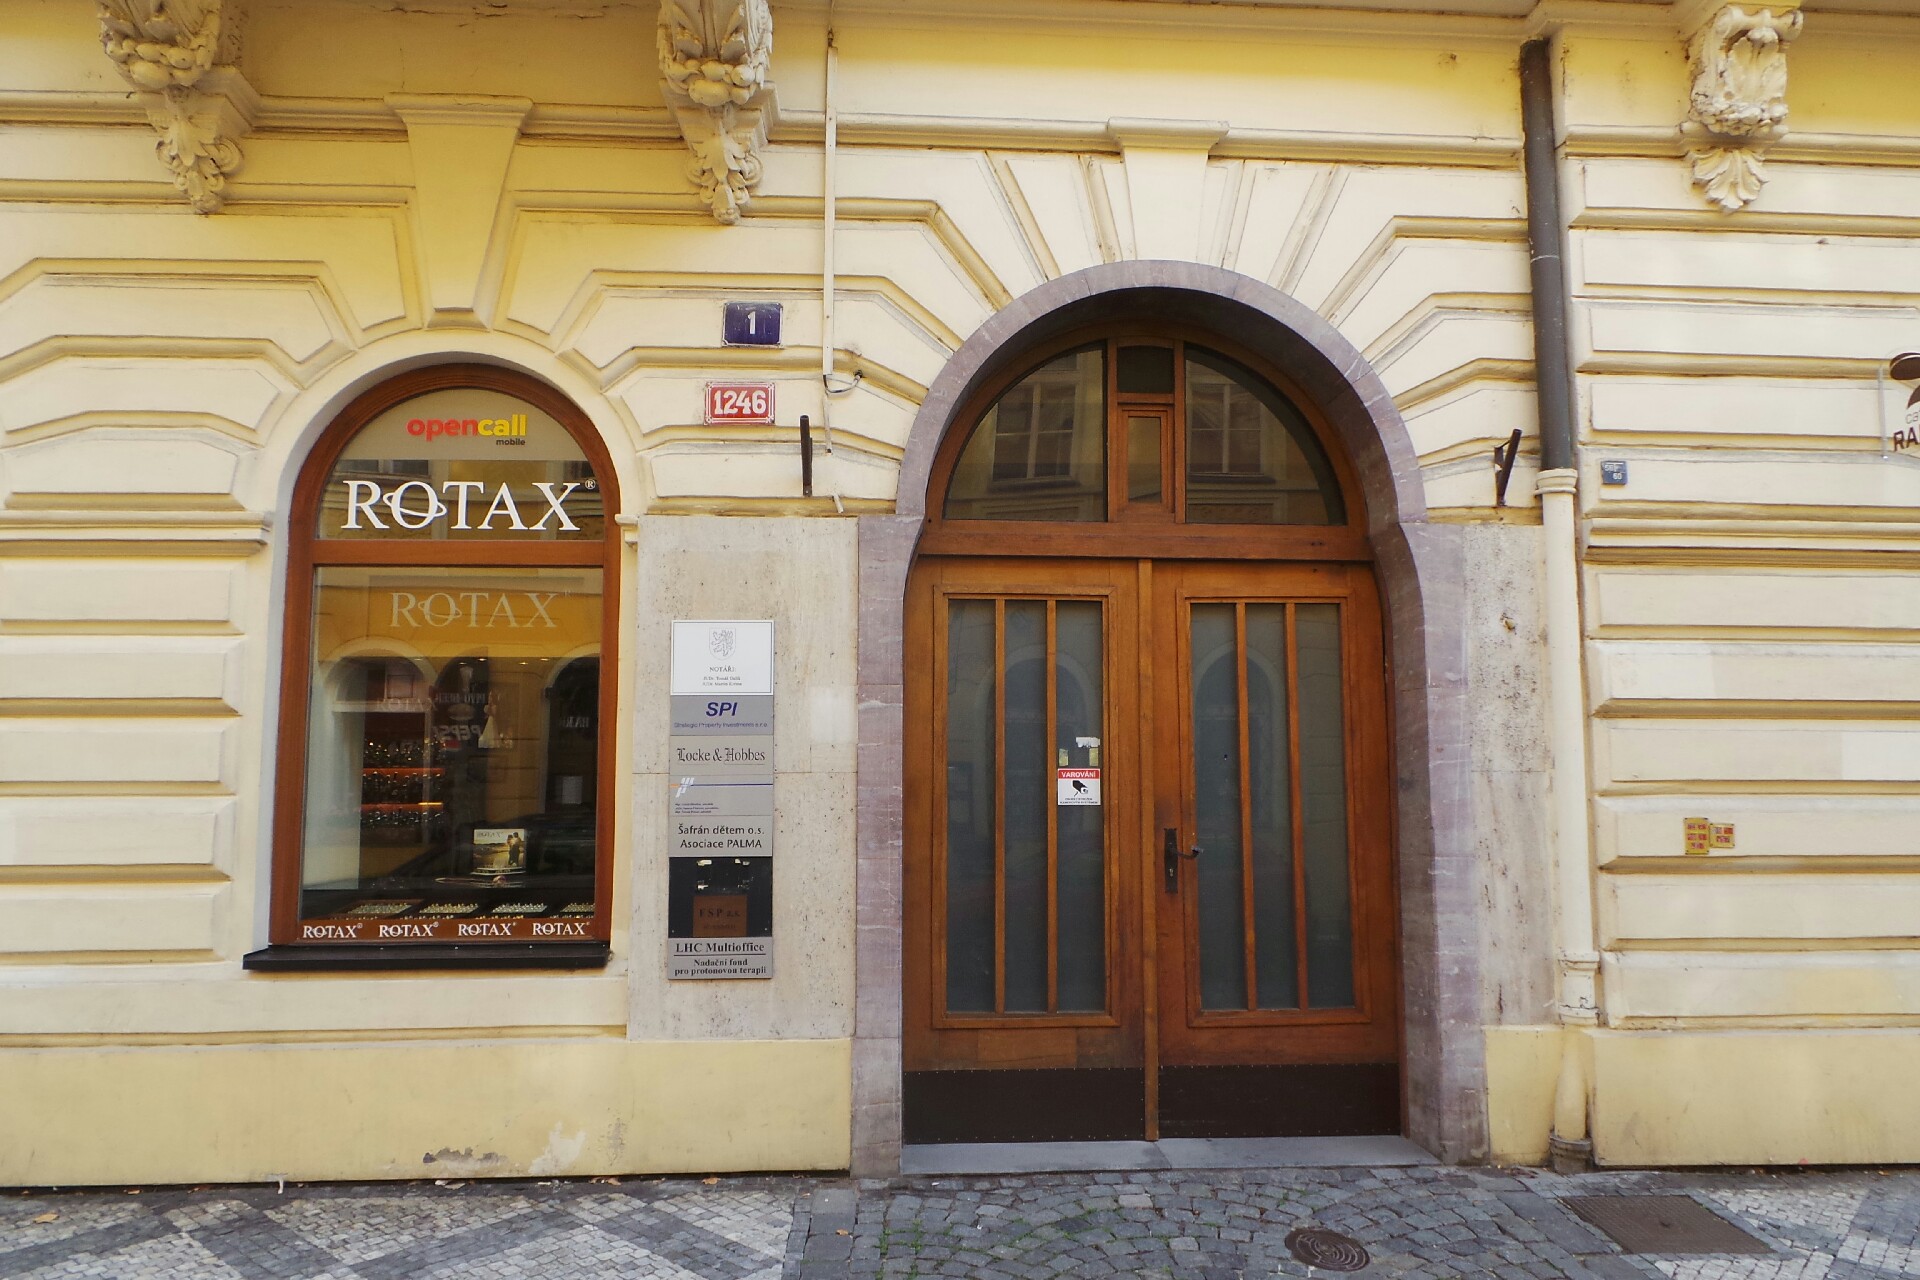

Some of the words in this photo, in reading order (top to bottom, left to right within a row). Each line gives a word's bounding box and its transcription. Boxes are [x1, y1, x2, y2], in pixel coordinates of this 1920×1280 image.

[747, 311, 756, 335] 1
[714, 389, 767, 415] 1246
[406, 414, 527, 442] opencall
[496, 438, 526, 446] mobile
[1893, 424, 1920, 452] RA
[705, 701, 738, 717] SPI
[676, 747, 711, 762] Locke
[713, 747, 723, 762] &
[724, 747, 766, 762] Hobbes
[1061, 770, 1096, 778] VAROVÁNÍ
[678, 822, 710, 835] Šafrán
[713, 825, 745, 835] dětem
[747, 827, 765, 835] o.s.
[680, 839, 724, 848] Asociace
[726, 839, 762, 848] PALMA
[676, 943, 703, 953] LHC
[706, 942, 765, 953] Multioffice
[729, 958, 748, 966] fond
[674, 968, 689, 976] pro
[691, 967, 737, 976] protonovou
[739, 967, 767, 975] terapii
